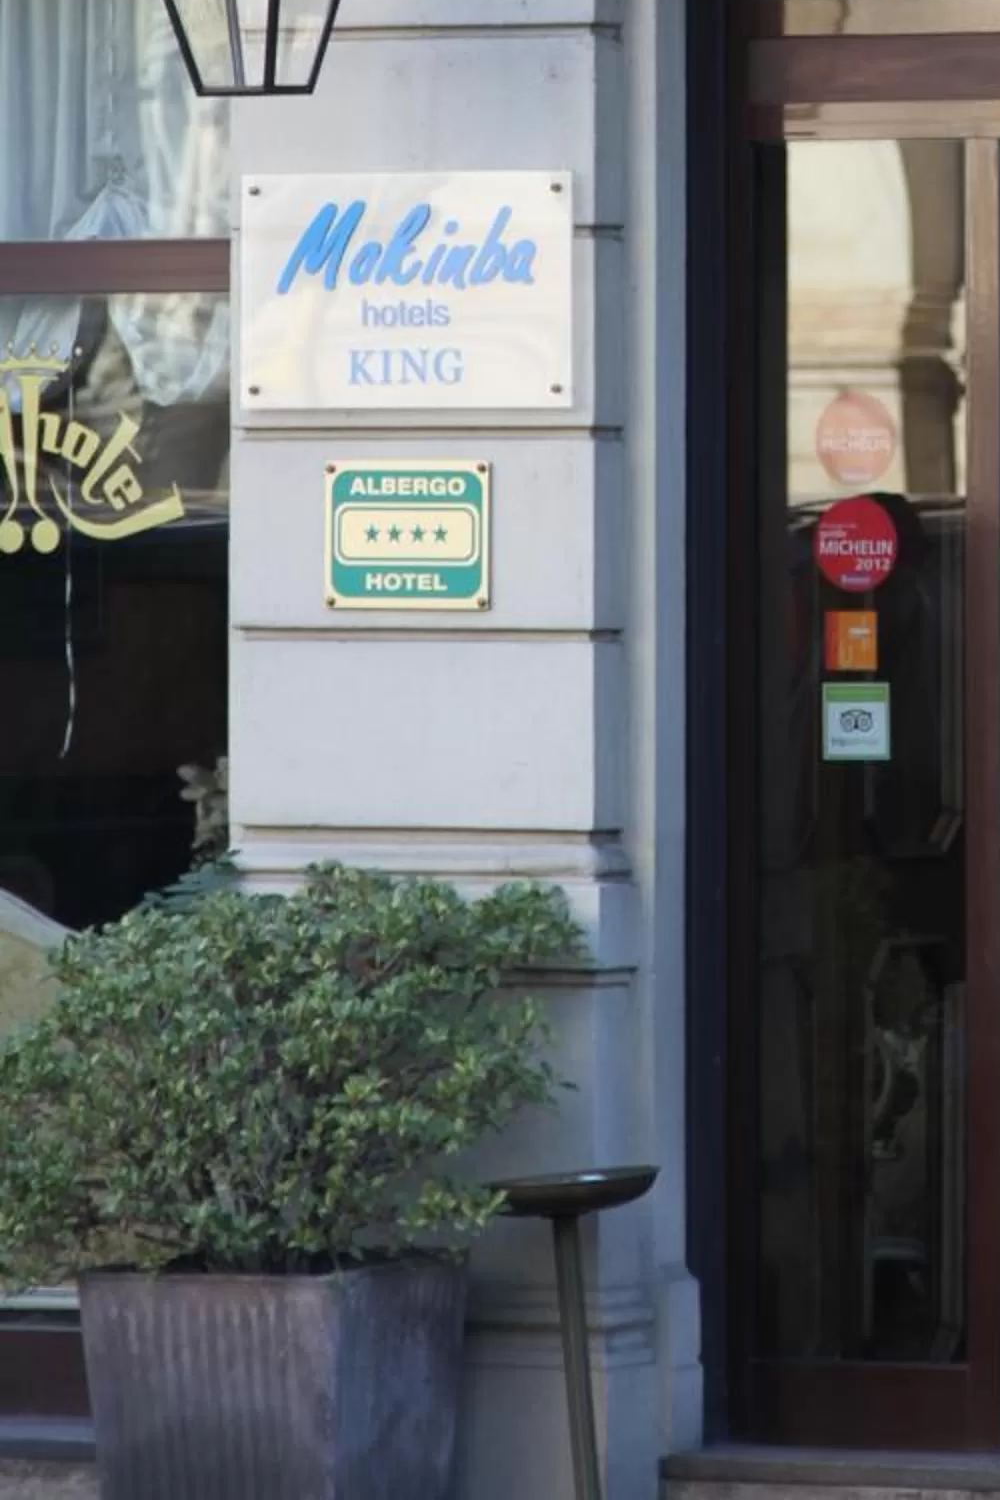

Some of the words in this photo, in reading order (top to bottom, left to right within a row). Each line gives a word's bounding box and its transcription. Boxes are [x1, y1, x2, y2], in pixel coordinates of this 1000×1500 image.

[276, 199, 538, 295] Mokinba
[361, 298, 452, 329] hotels
[348, 348, 465, 386] KING
[350, 476, 467, 496] ALBERGO
[819, 540, 893, 556] MICHELIN
[365, 572, 448, 592] HOTEL
